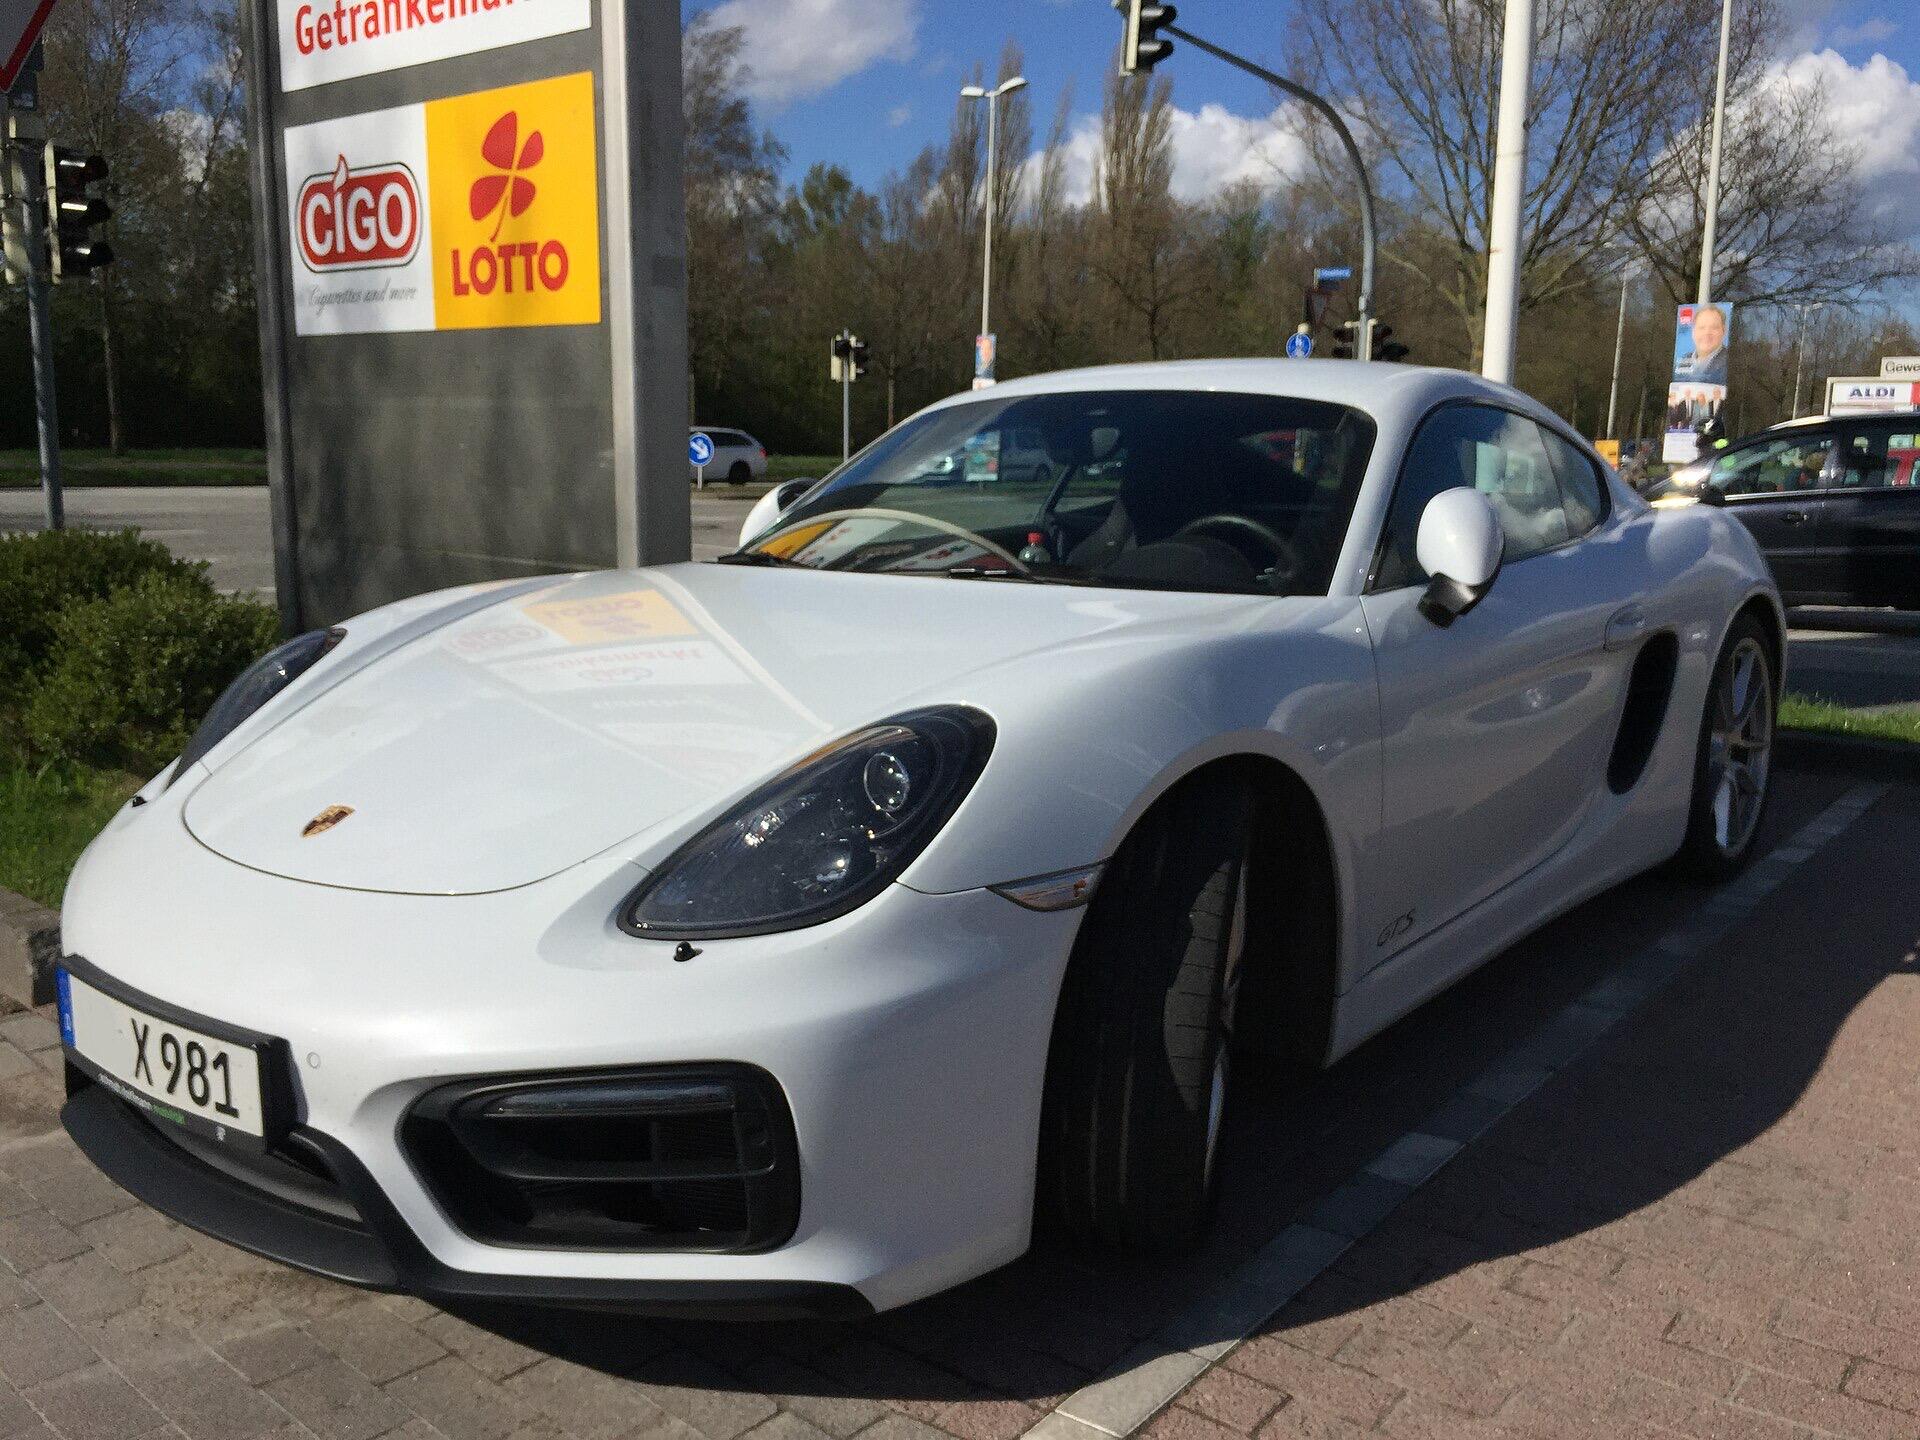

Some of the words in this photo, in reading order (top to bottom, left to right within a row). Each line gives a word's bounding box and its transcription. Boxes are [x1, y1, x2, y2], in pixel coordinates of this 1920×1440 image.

[451, 239, 570, 297] LOTTO
[1849, 386, 1896, 398] ALDI
[131, 1018, 154, 1087] X
[160, 1032, 240, 1119] 981
